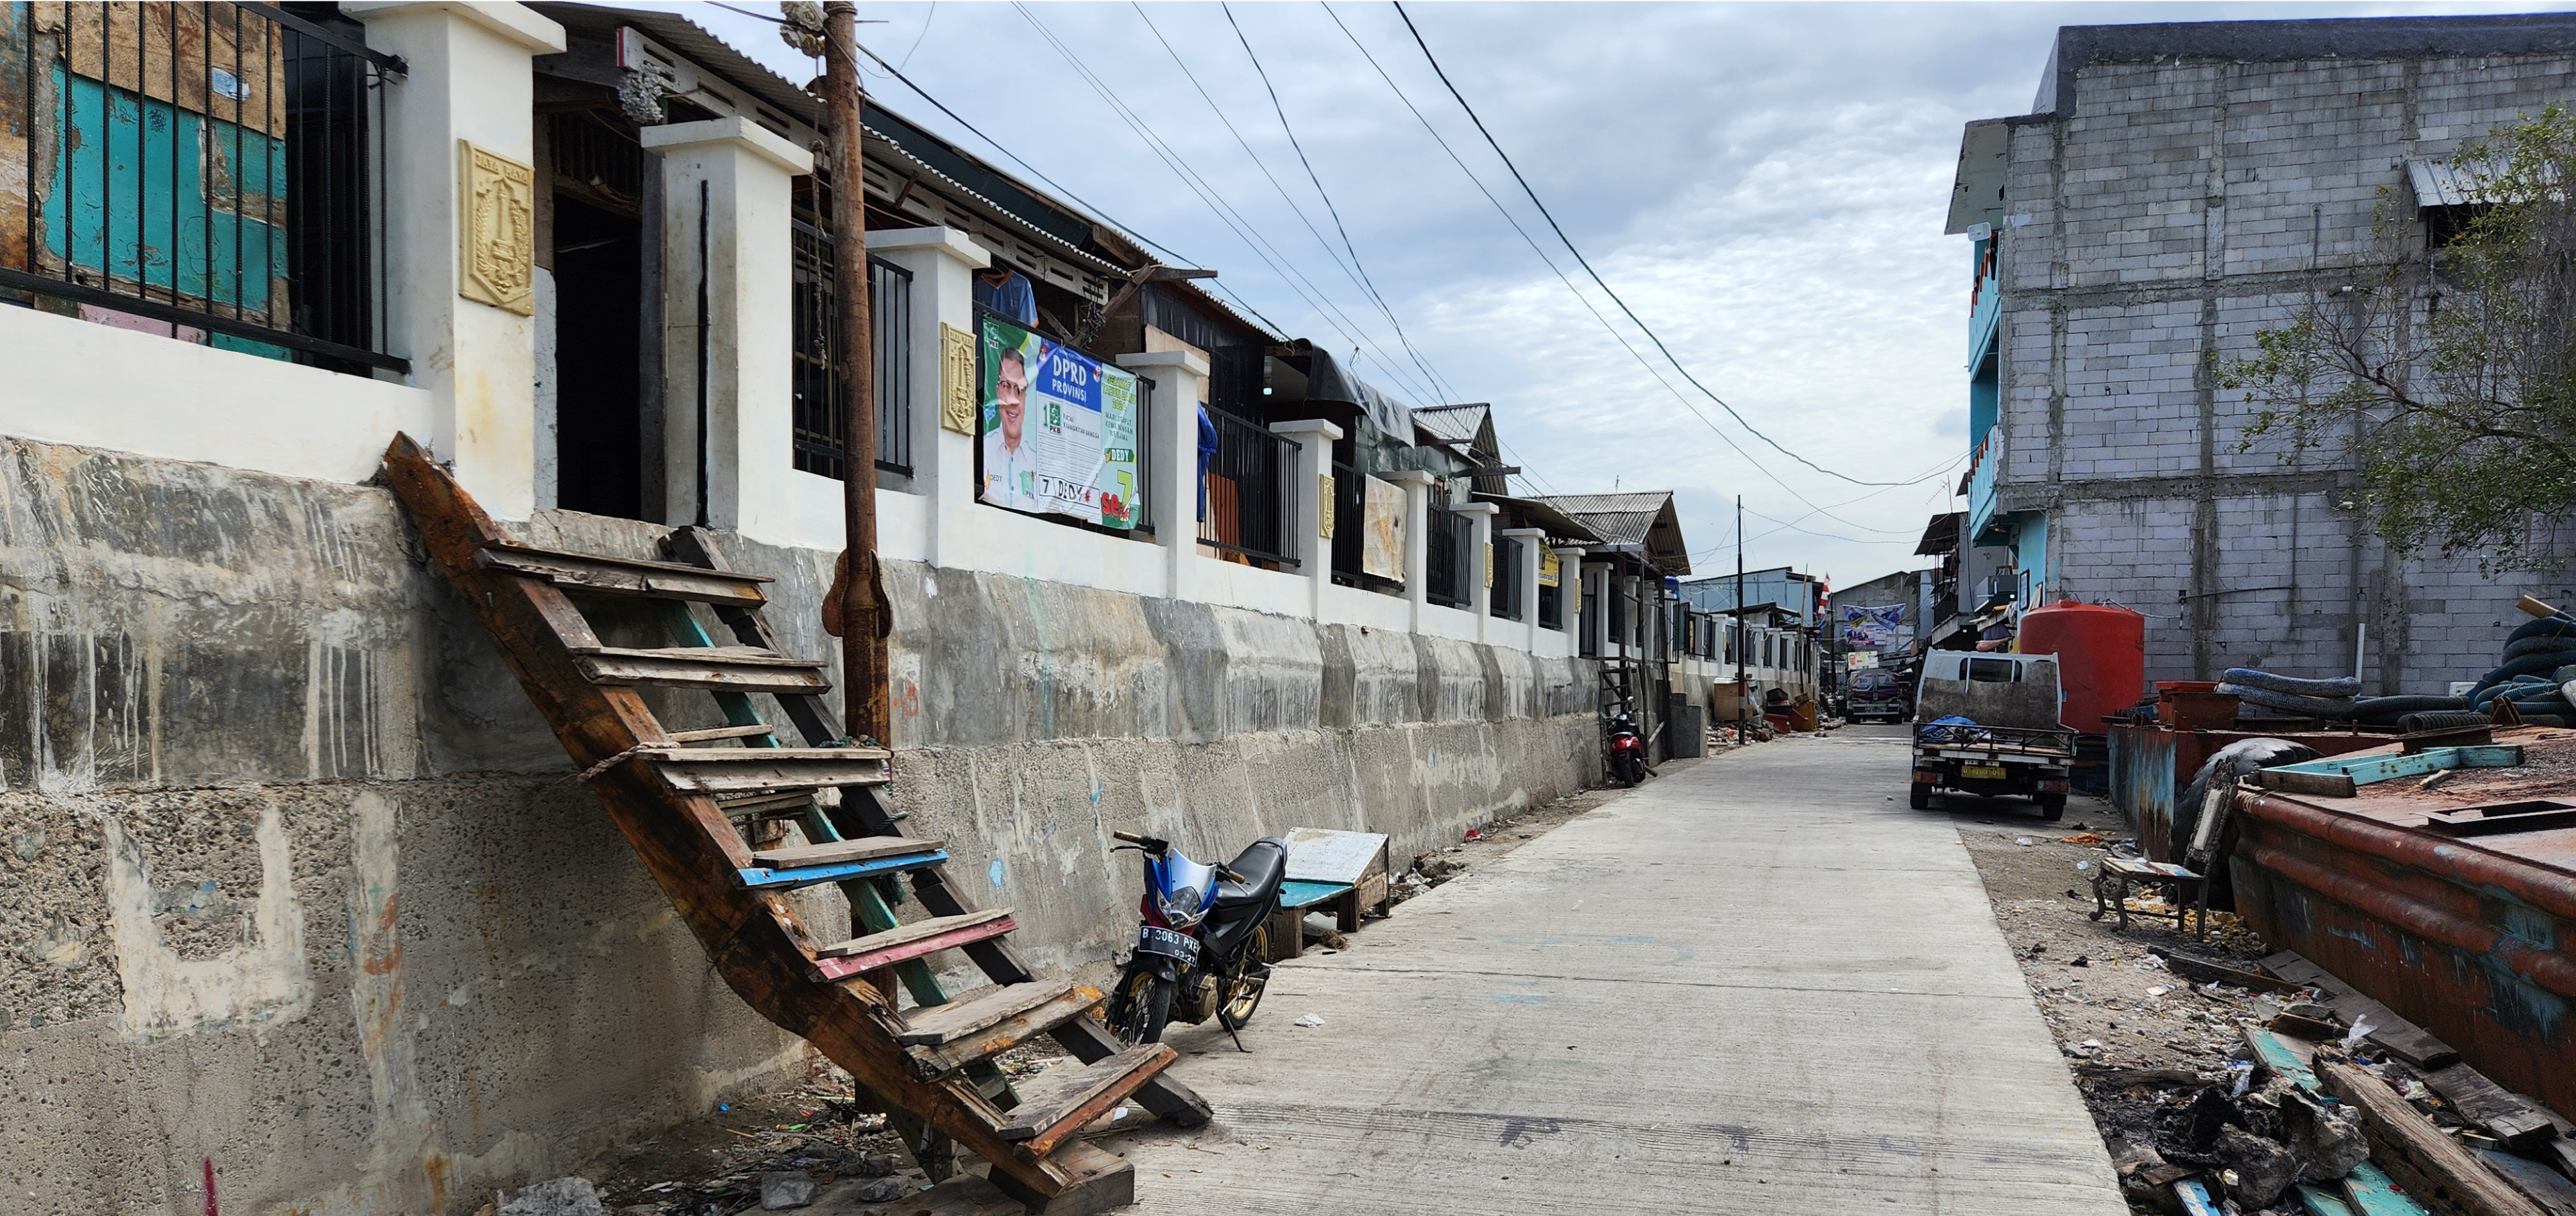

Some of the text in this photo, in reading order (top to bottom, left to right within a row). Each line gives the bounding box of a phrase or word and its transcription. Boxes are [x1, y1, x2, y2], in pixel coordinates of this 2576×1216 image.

[503, 165, 527, 182] RAYA
[1053, 354, 1087, 386] DPRD
[1052, 378, 1087, 402] PROVINSI
[1102, 382, 1121, 399] TAHUN
[1049, 425, 1061, 434] PKB
[1111, 449, 1130, 461] DEDY
[1042, 479, 1083, 502] 7 DEDY
[1142, 928, 1197, 952] B 3063 PXE
